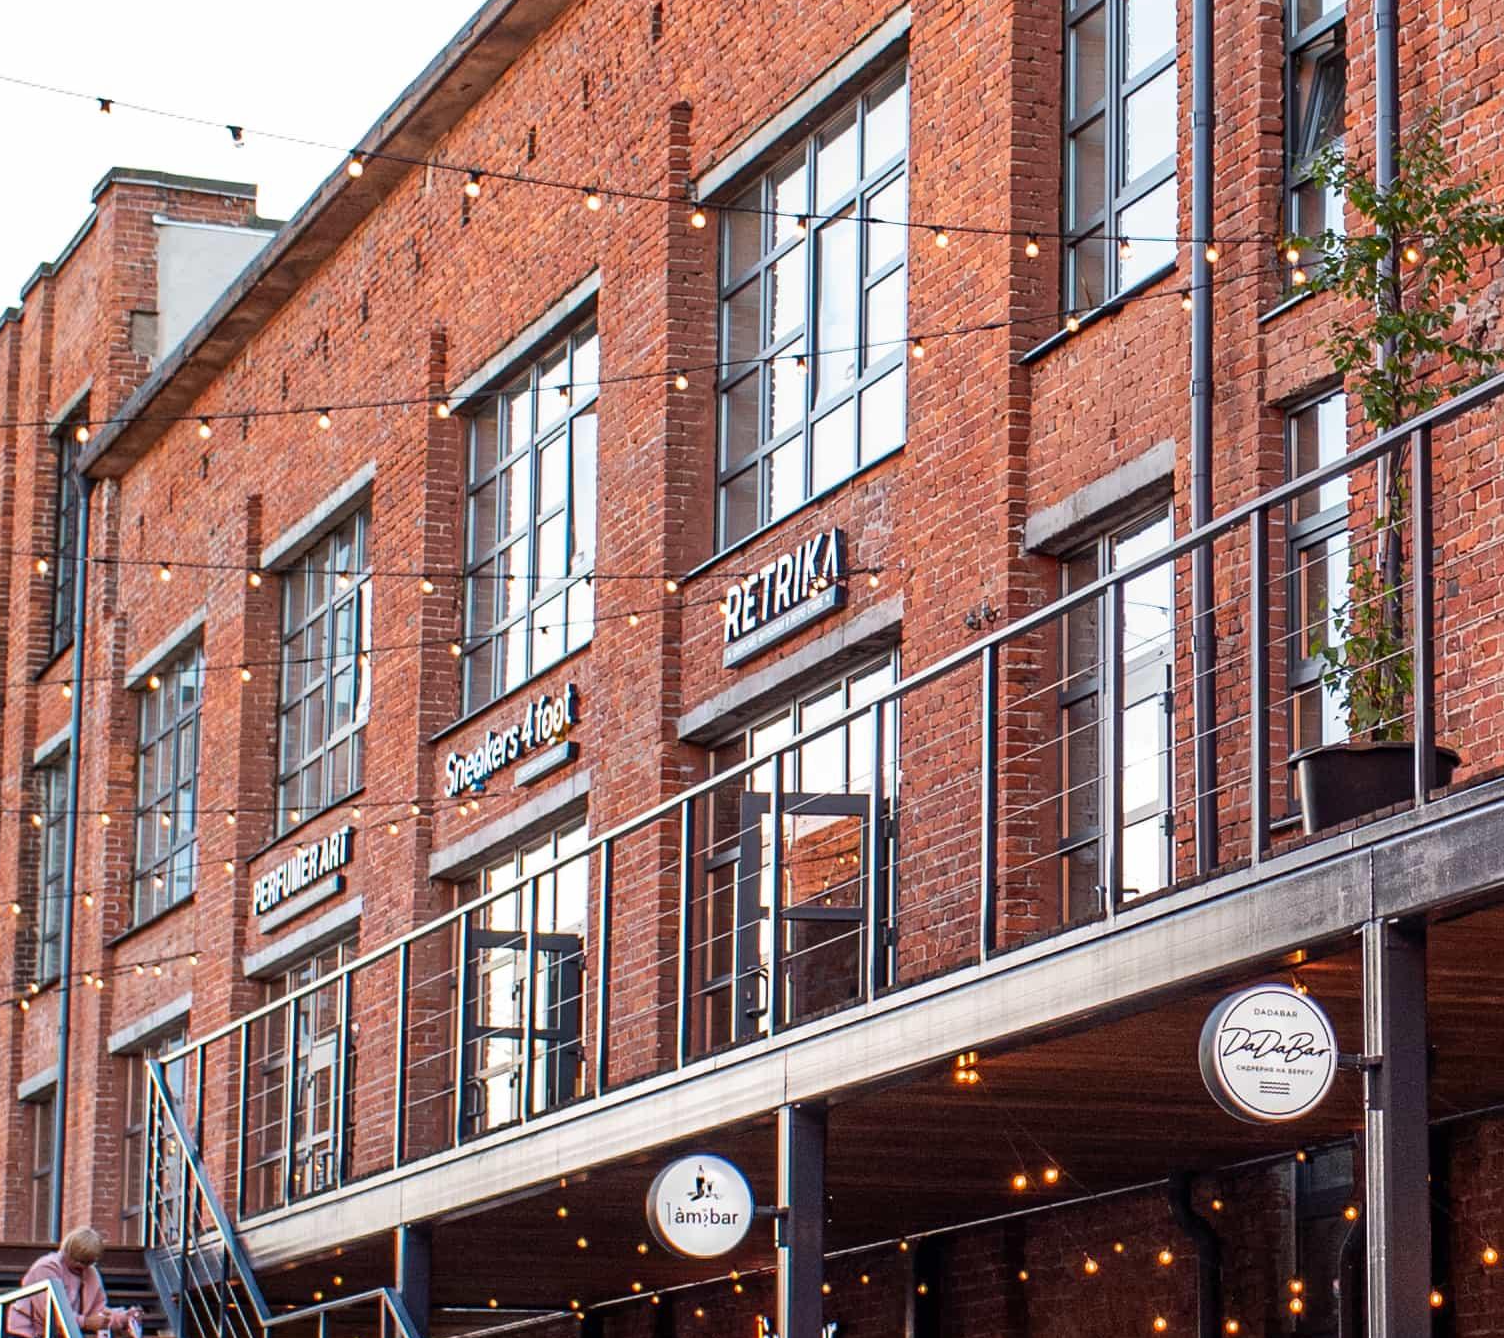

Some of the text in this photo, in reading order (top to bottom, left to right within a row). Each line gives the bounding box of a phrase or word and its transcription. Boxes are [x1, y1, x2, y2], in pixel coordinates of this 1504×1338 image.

[723, 527, 839, 643] RETRIKA
[444, 724, 520, 798] Sneakers
[520, 701, 534, 749] 4
[534, 682, 573, 744] foot
[1221, 1027, 1332, 1063] DaDaBar
[1253, 1007, 1299, 1019] DADABAR
